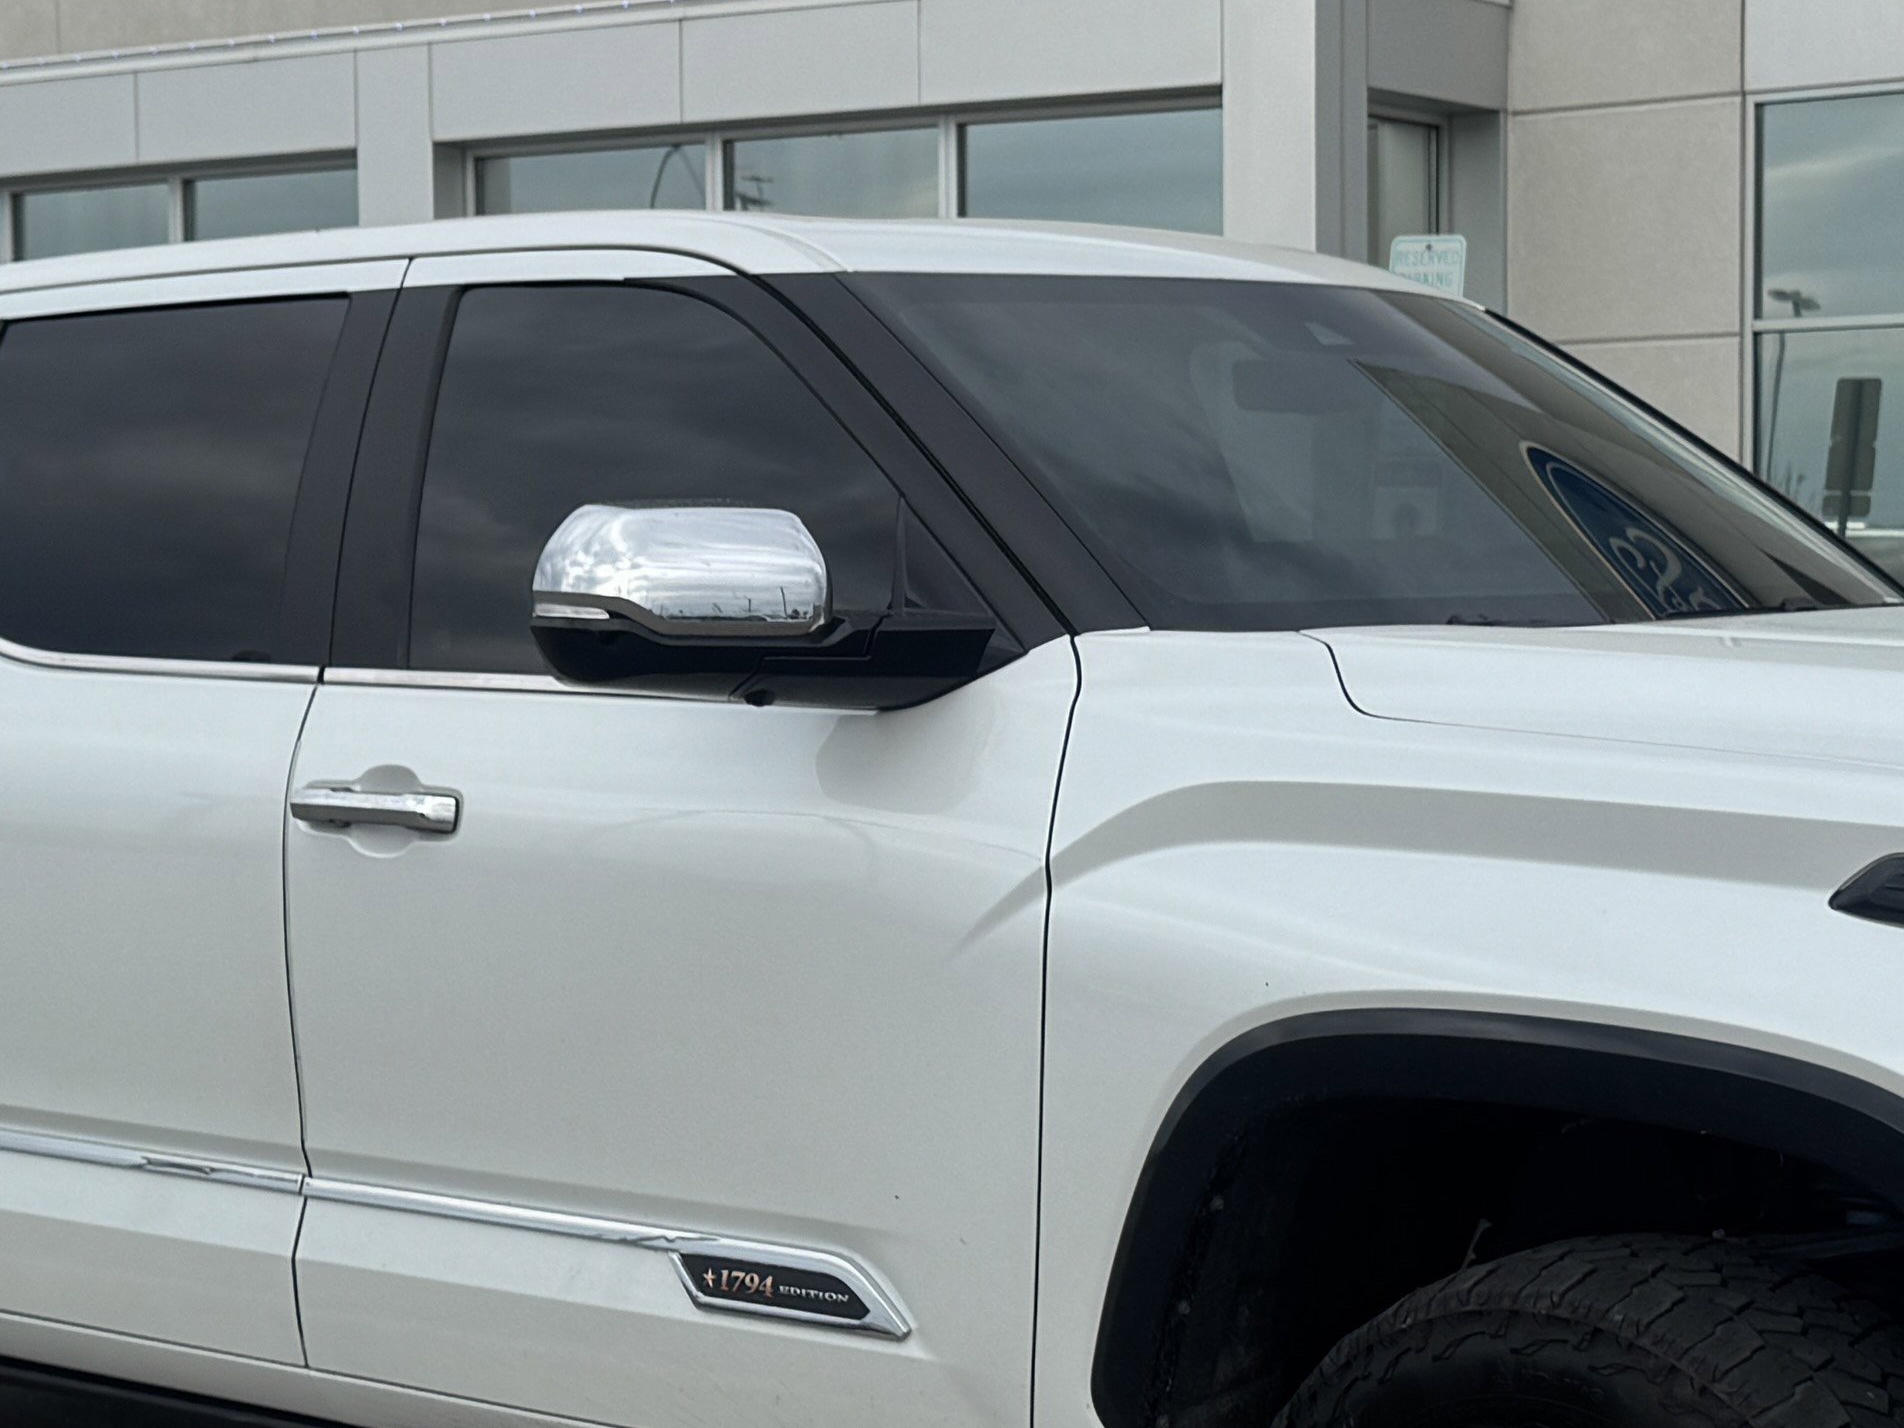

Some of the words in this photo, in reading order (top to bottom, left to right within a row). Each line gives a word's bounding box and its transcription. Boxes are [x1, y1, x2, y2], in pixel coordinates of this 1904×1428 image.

[1394, 250, 1460, 268] RESERVED
[719, 1269, 775, 1299] 1794
[778, 1285, 850, 1303] EDITION
